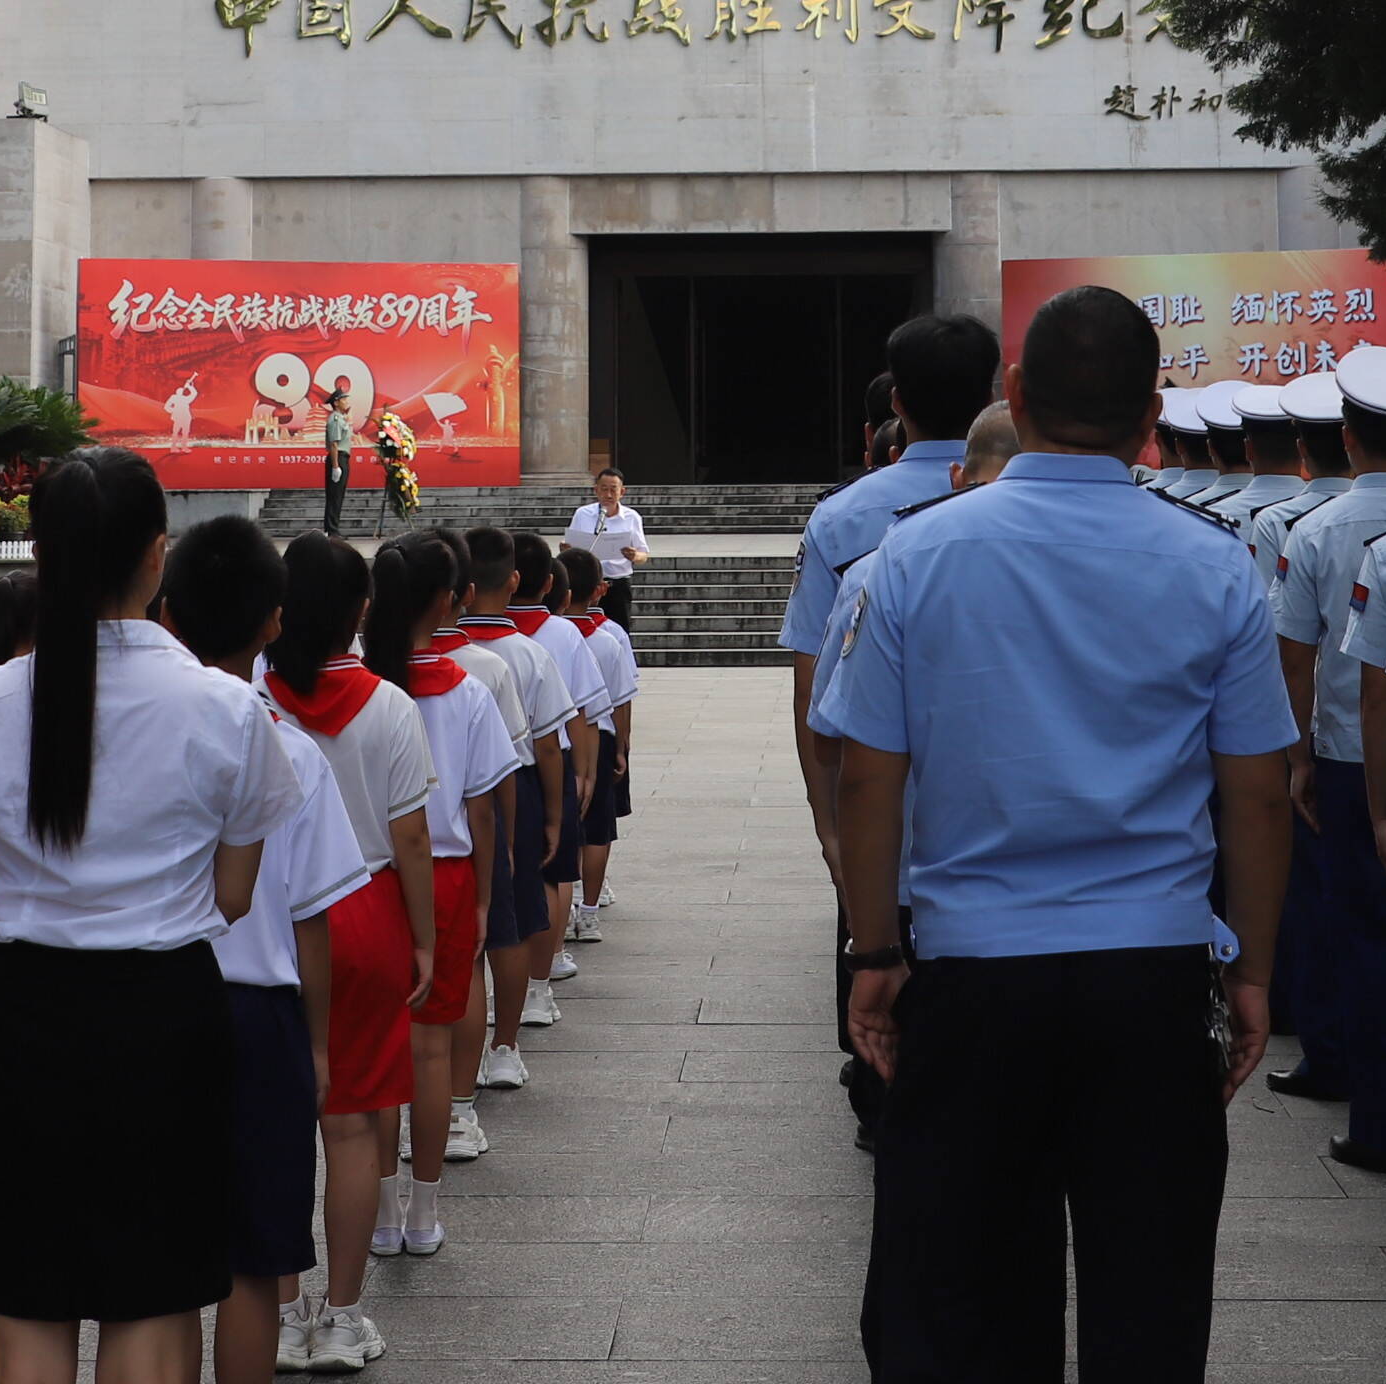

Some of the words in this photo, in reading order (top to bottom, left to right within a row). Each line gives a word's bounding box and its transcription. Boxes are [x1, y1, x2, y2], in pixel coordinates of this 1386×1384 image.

[108, 279, 493, 356] 纪念全民族抗战爆发89周年
[1230, 287, 1377, 325] 缅怀英烈
[1237, 338, 1374, 378] 开创未
[254, 352, 375, 434] 89
